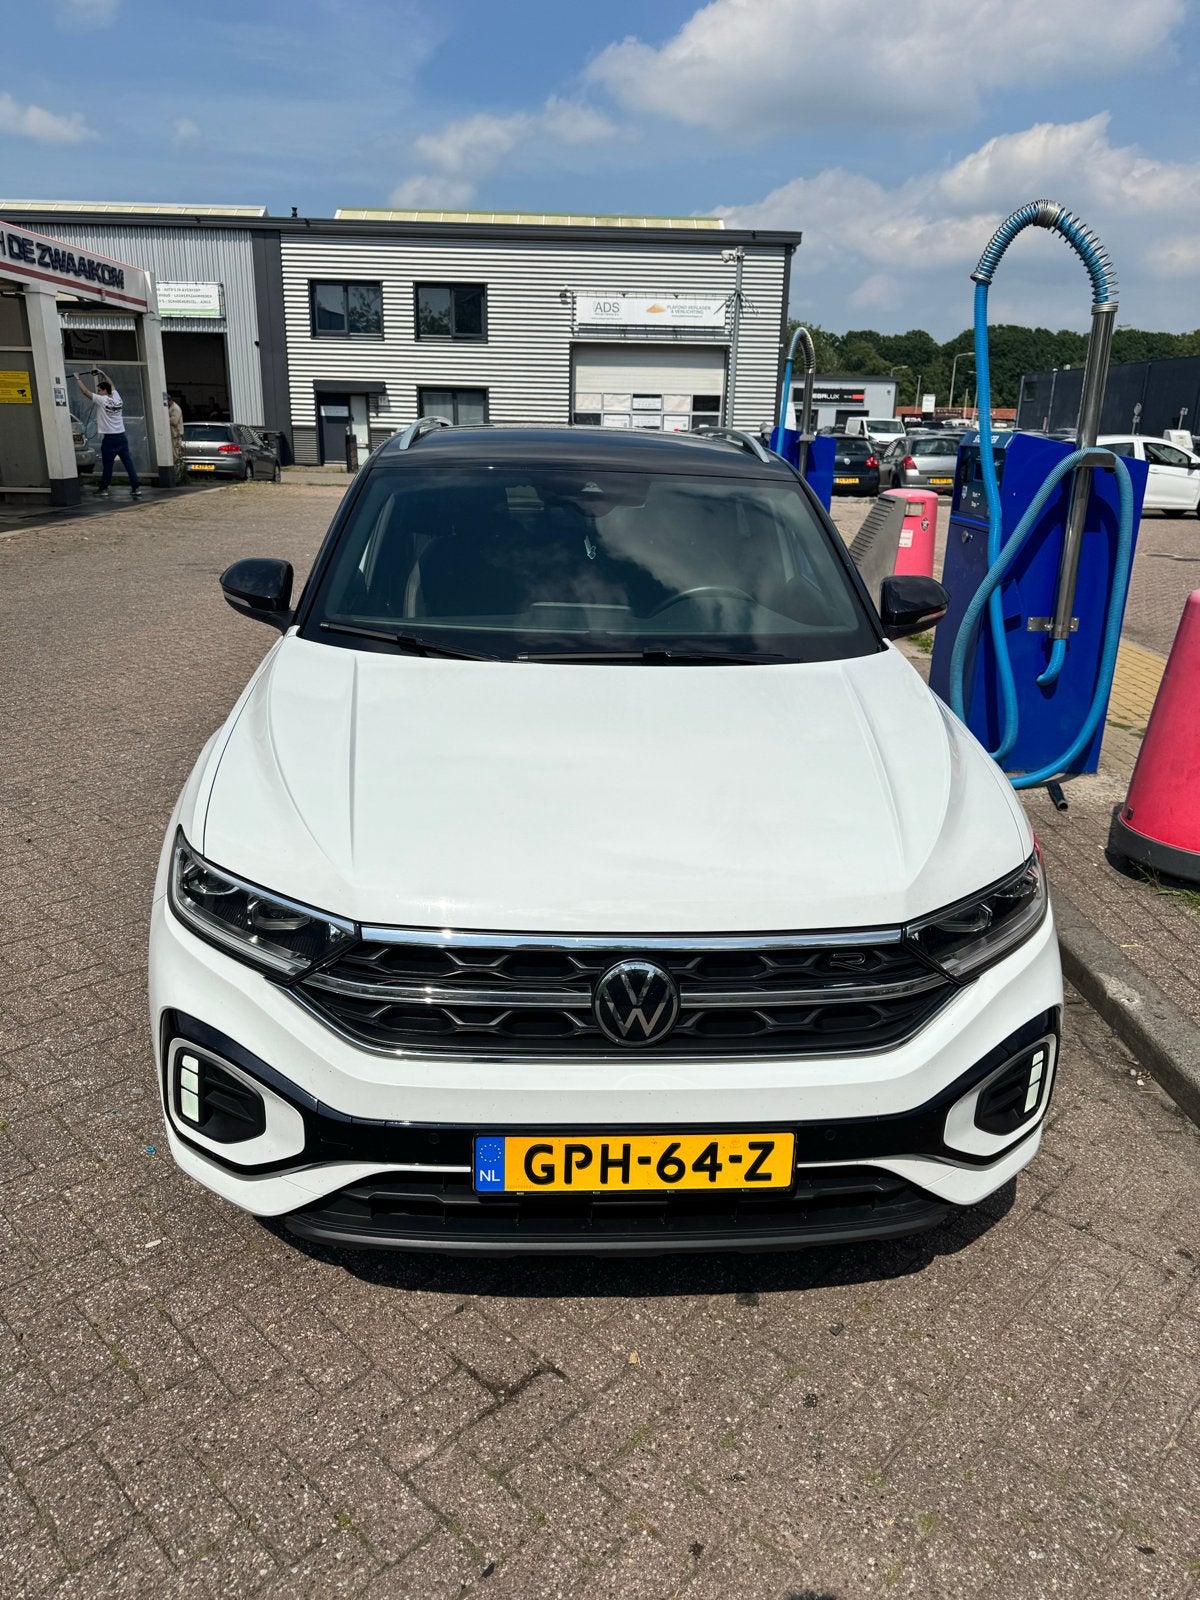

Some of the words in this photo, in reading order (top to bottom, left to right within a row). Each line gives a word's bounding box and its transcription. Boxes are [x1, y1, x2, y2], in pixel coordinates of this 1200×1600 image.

[7, 233, 36, 264] DE
[36, 242, 124, 289] ZWAAIKOM
[594, 302, 620, 313] ADS
[479, 1170, 501, 1182] NL
[523, 1141, 775, 1185] GPH-64-Z
